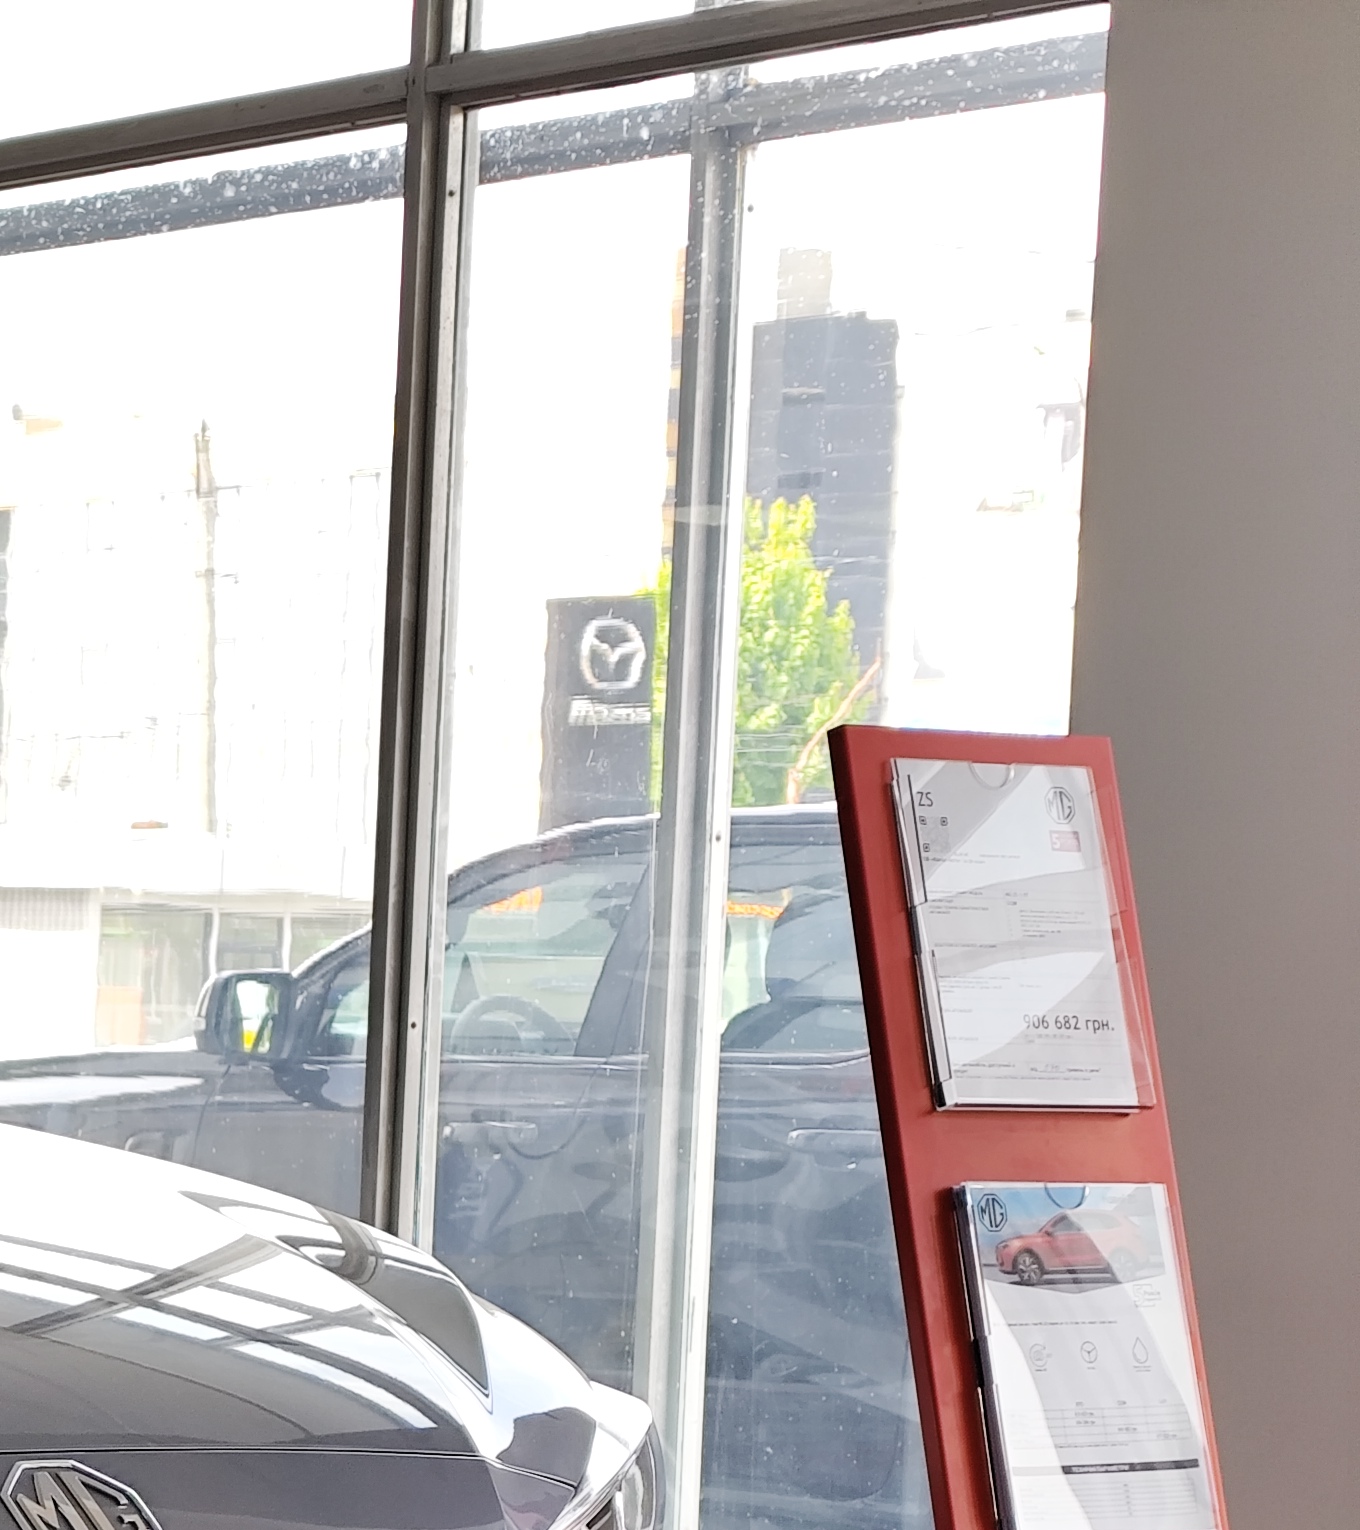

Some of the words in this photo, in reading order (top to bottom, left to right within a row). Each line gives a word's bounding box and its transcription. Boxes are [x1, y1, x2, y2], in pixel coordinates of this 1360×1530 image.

[917, 791, 934, 807] ZS
[1046, 789, 1073, 822] MG
[1023, 1013, 1050, 1030] 906
[1054, 1014, 1081, 1031] 682
[1084, 1018, 1115, 1035] грн.
[979, 1196, 1005, 1229] MG
